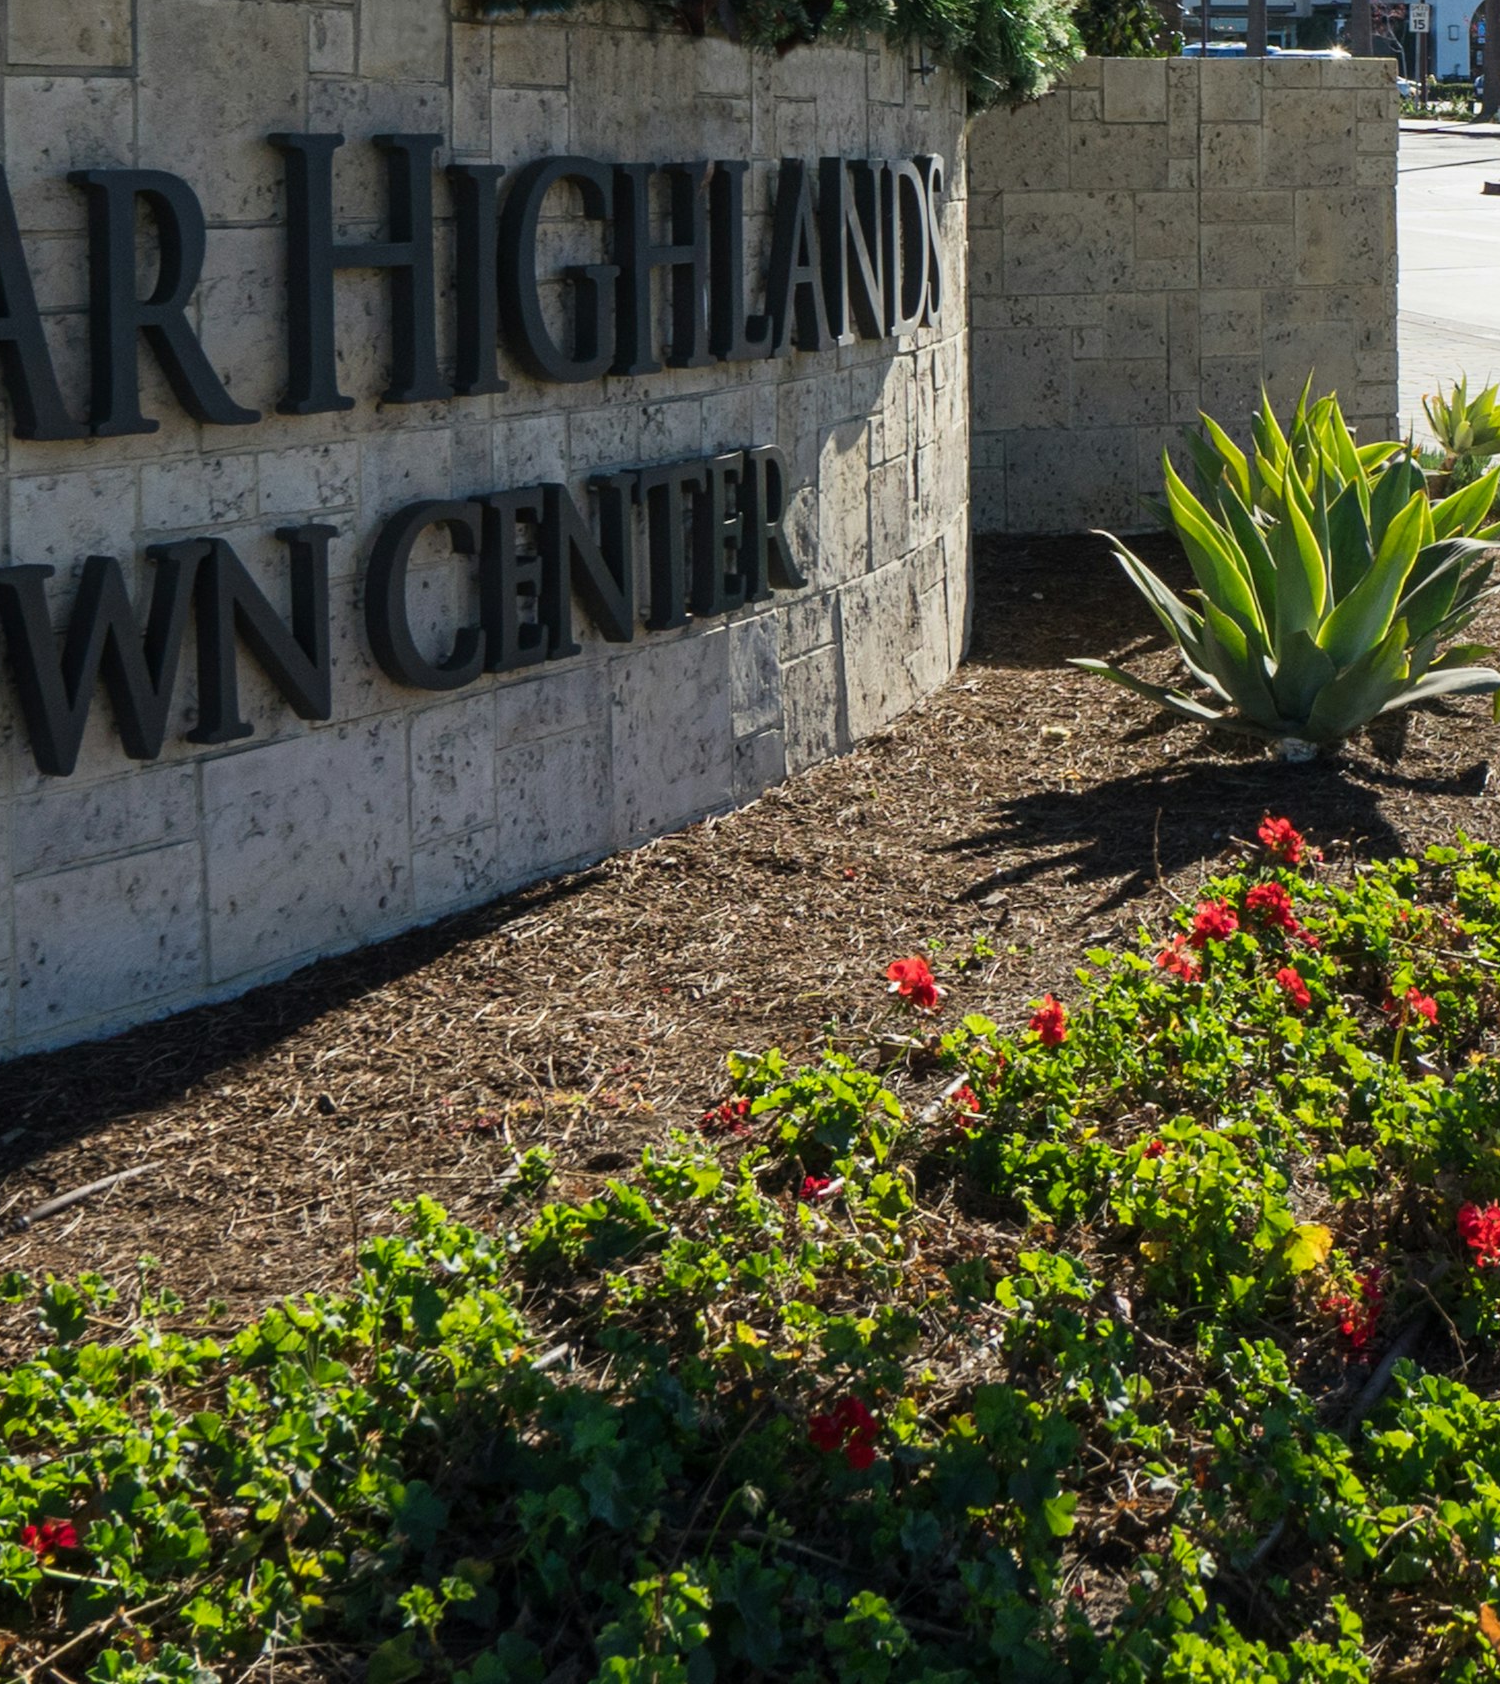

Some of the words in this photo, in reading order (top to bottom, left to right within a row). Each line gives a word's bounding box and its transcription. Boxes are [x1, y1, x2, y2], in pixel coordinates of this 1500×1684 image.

[1413, 19, 1426, 30] 15
[267, 131, 945, 416] HIGHLANDS
[364, 444, 808, 691] CENTER
